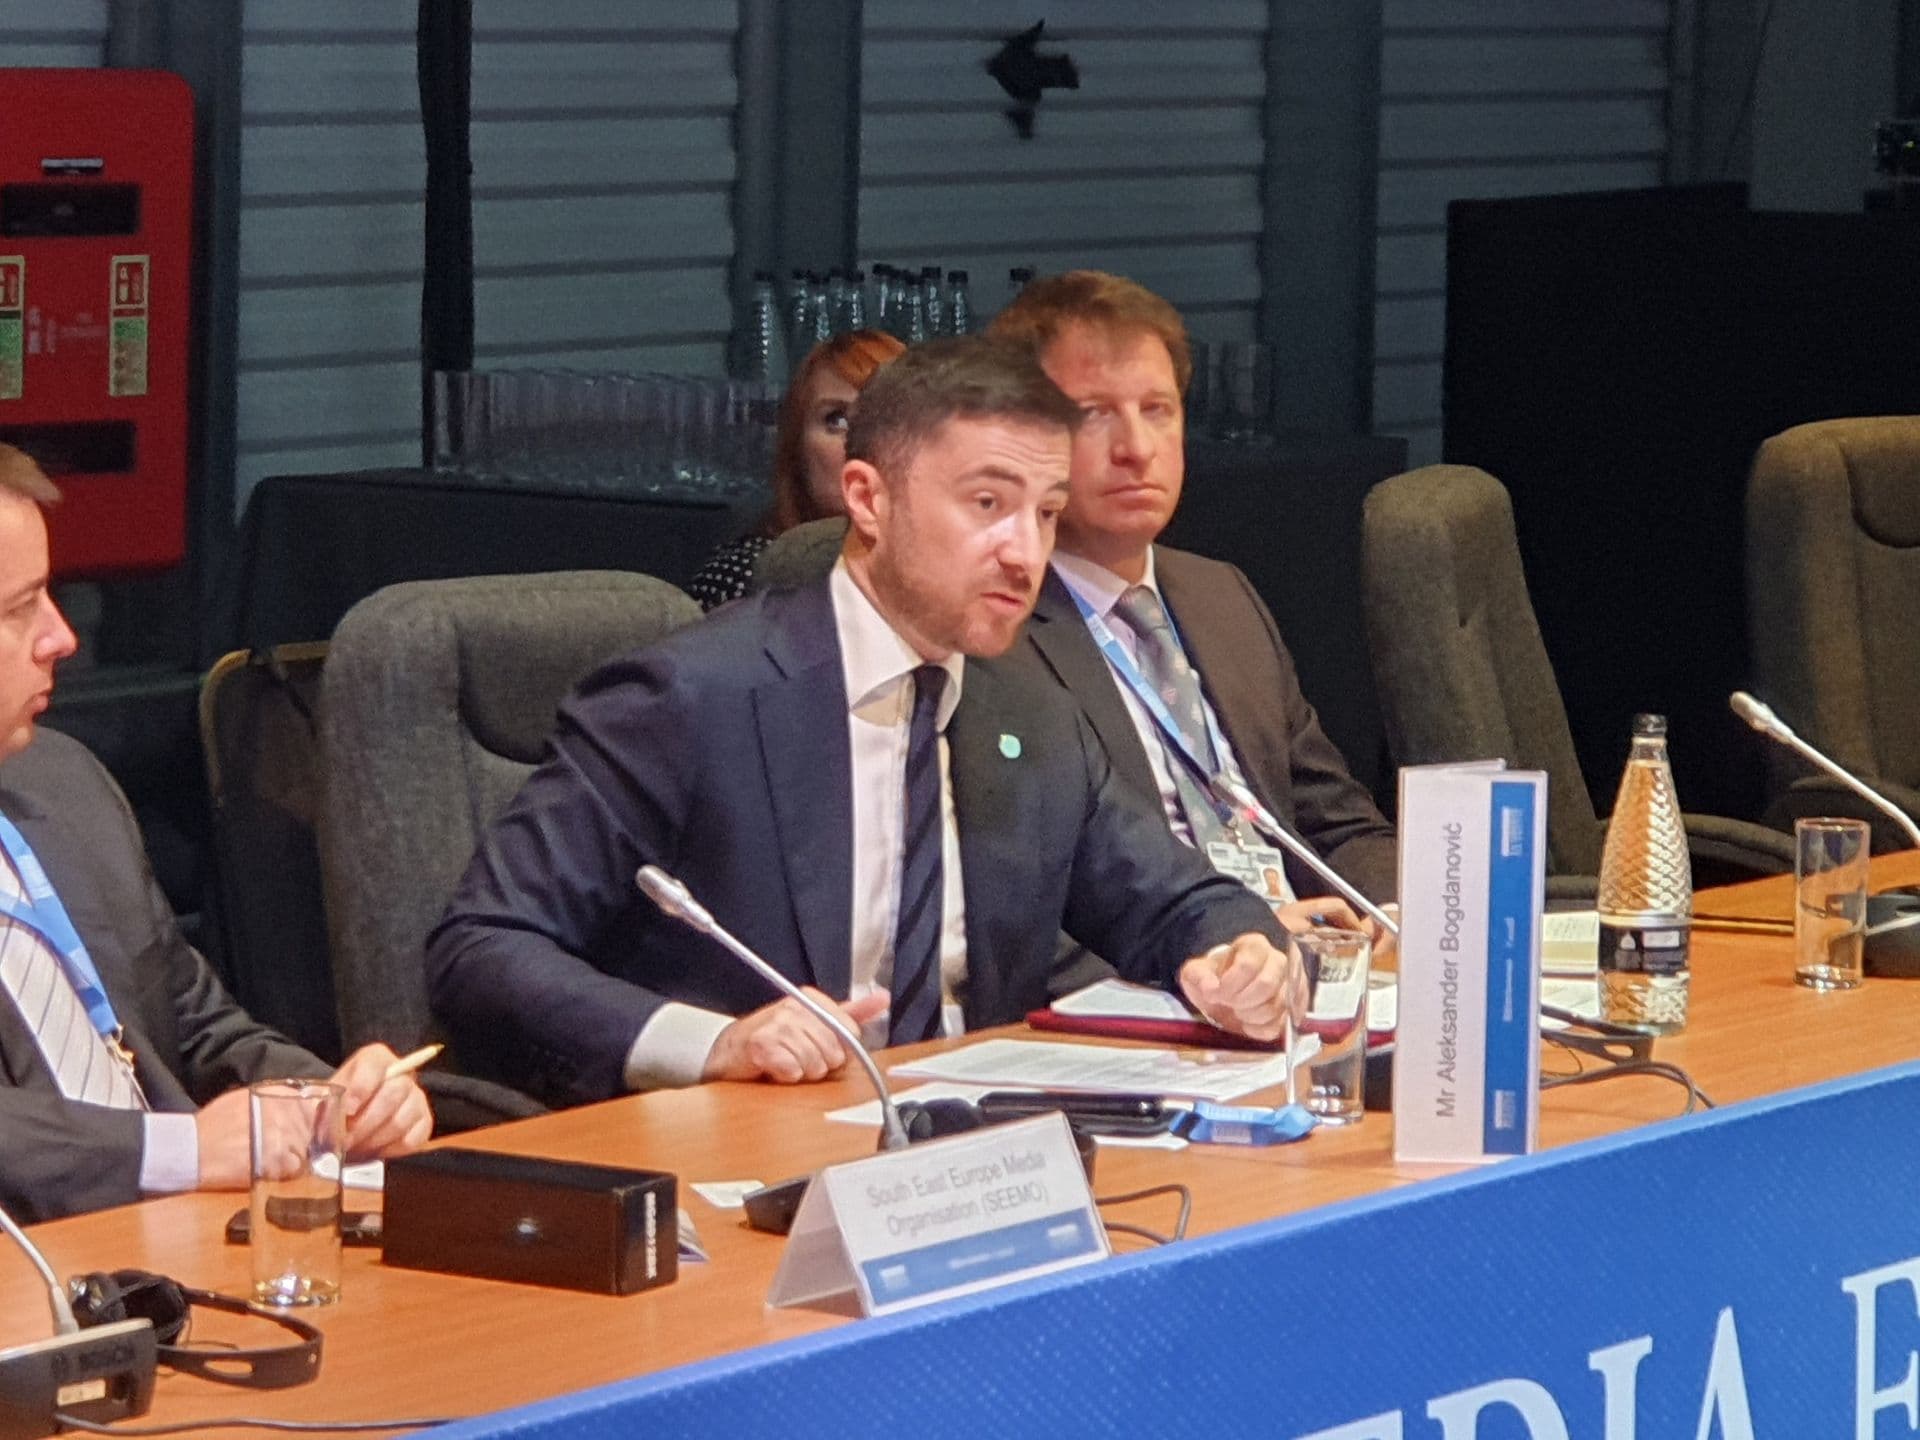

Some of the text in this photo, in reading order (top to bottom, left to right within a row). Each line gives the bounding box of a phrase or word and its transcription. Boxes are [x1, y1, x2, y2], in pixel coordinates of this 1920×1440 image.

[1436, 822, 1465, 1118] Mr Aleksander Bogdanović
[867, 1151, 1047, 1208] South East Europe Media
[983, 1181, 1049, 1215] (SEEMO)
